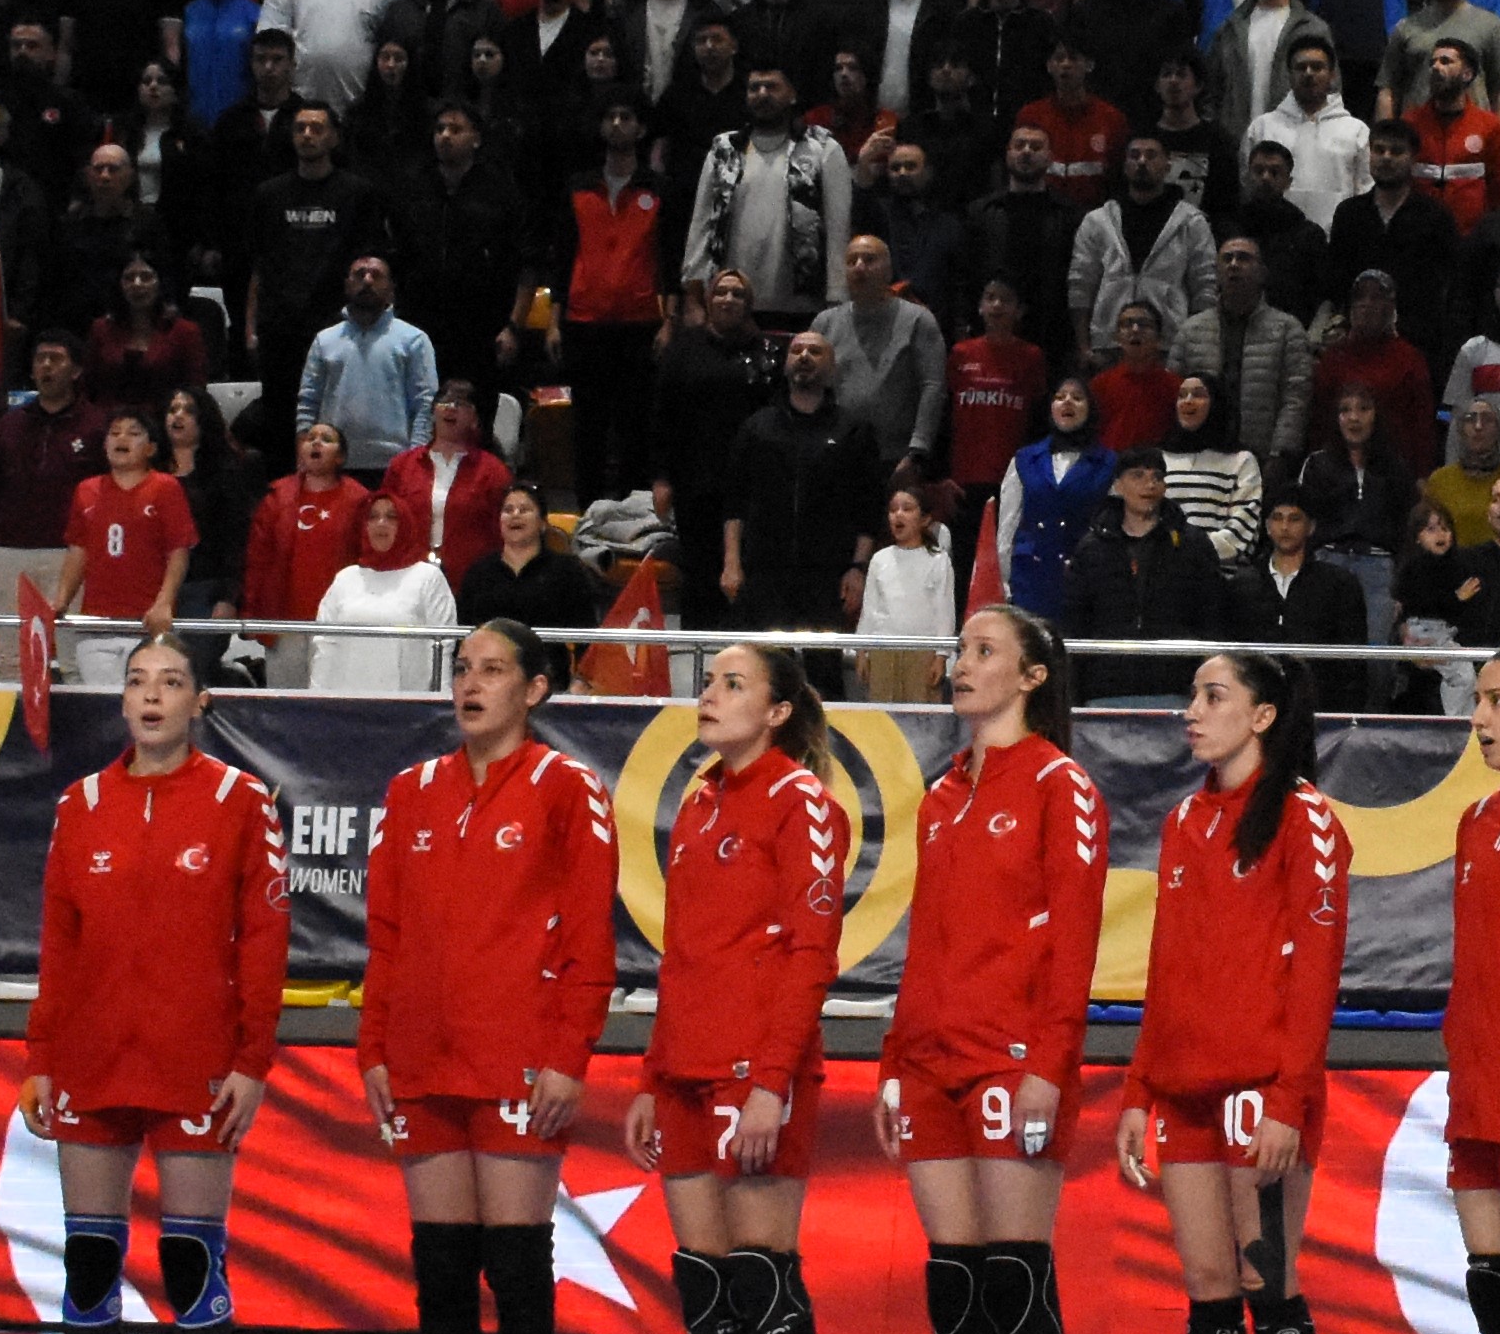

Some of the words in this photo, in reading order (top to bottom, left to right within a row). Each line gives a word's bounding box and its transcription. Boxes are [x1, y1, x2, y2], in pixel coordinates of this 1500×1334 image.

[284, 208, 337, 223] WHEN
[106, 522, 125, 557] 8
[291, 805, 359, 855] EHF
[499, 1098, 531, 1136] 4
[981, 1085, 1011, 1141] 9
[1223, 1089, 1264, 1147] 10
